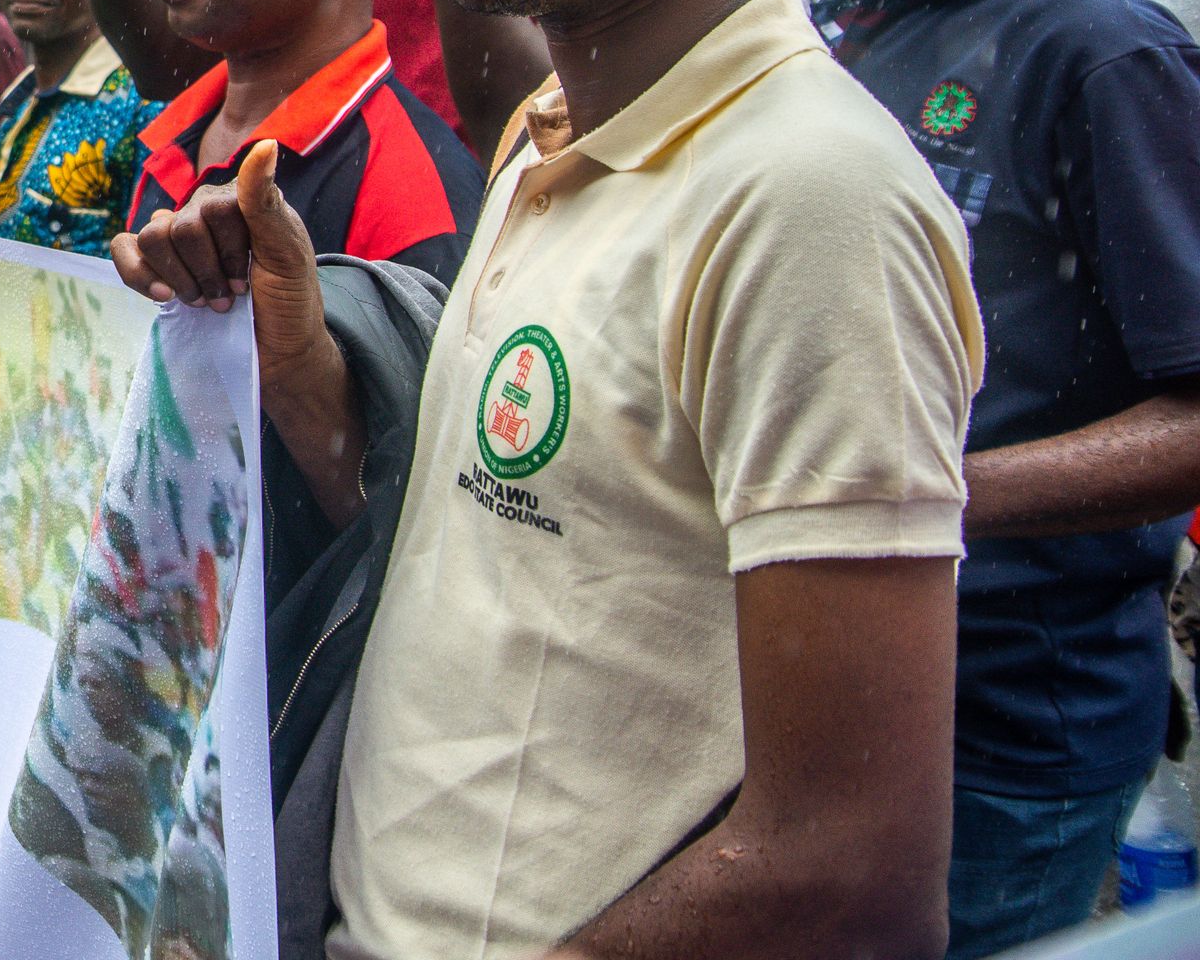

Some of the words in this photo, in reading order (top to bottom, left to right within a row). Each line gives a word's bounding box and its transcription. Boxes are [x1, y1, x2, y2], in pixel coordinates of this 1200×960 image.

[554, 361, 567, 392] ARTS
[498, 461, 532, 474] NIGERIA
[458, 471, 475, 494] EDO
[495, 502, 564, 537] COUNCIL
